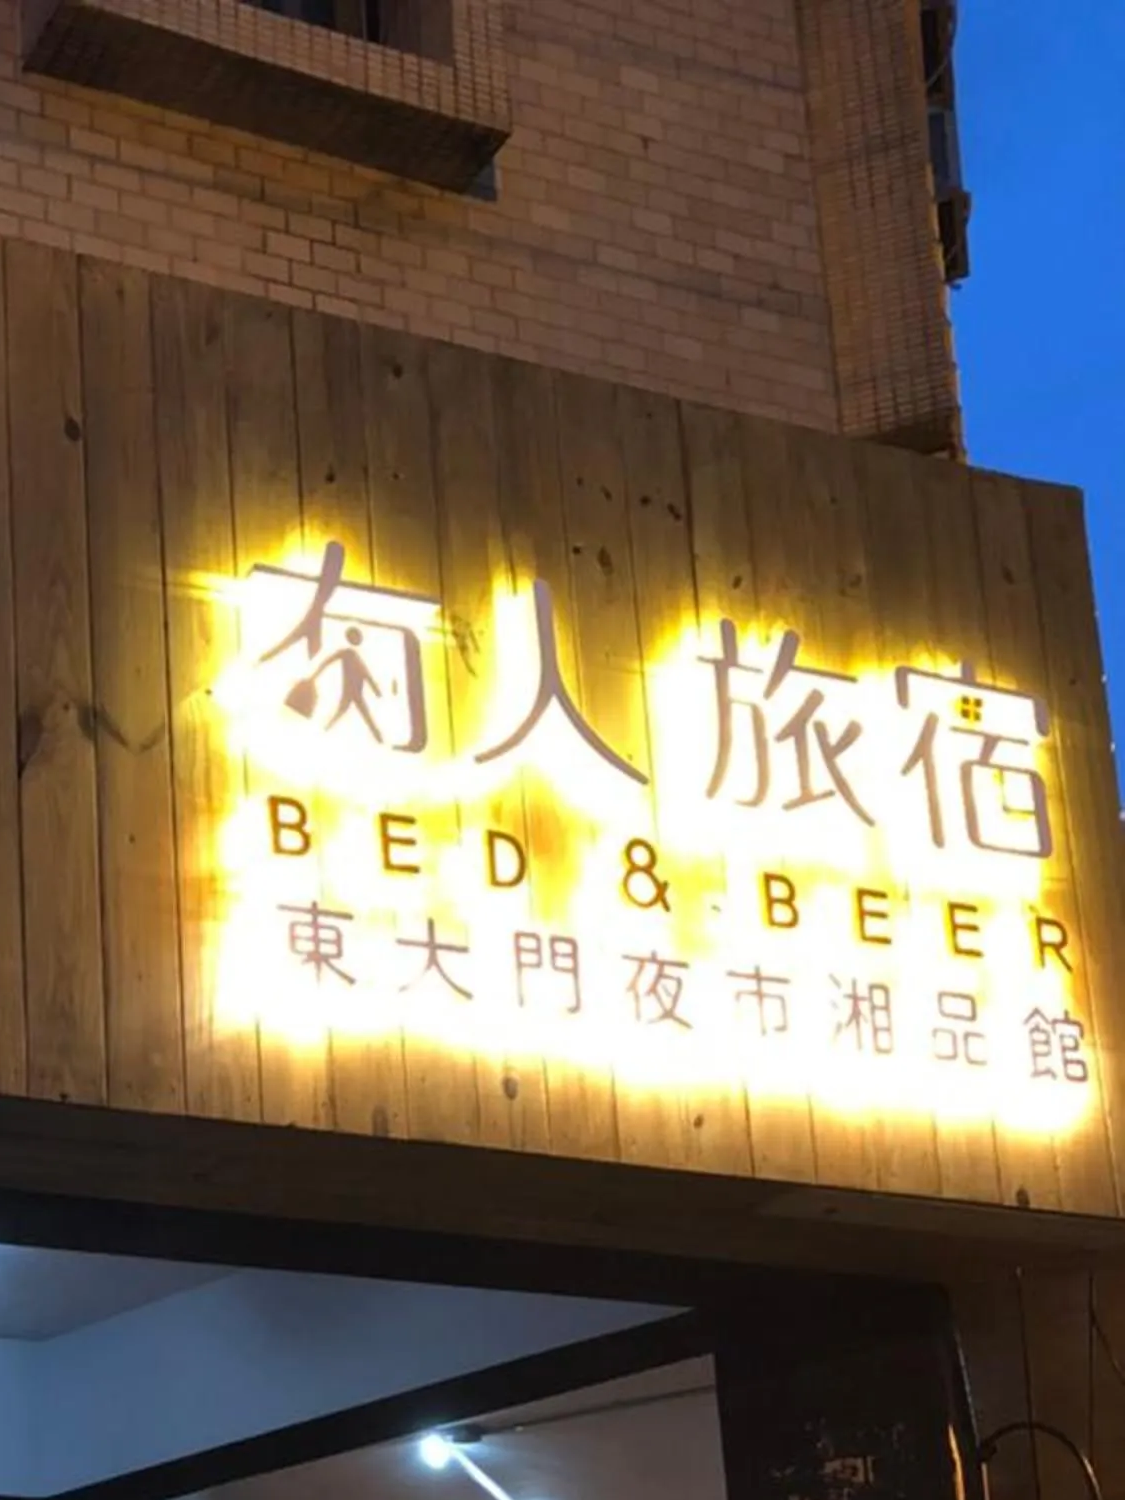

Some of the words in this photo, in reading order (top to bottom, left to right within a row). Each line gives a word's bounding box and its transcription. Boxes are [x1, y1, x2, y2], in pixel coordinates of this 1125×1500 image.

[267, 795, 527, 889] BED
[623, 838, 671, 913] &
[763, 873, 1073, 974] BEER
[277, 901, 1089, 1086] 東大門夜市湘品館
